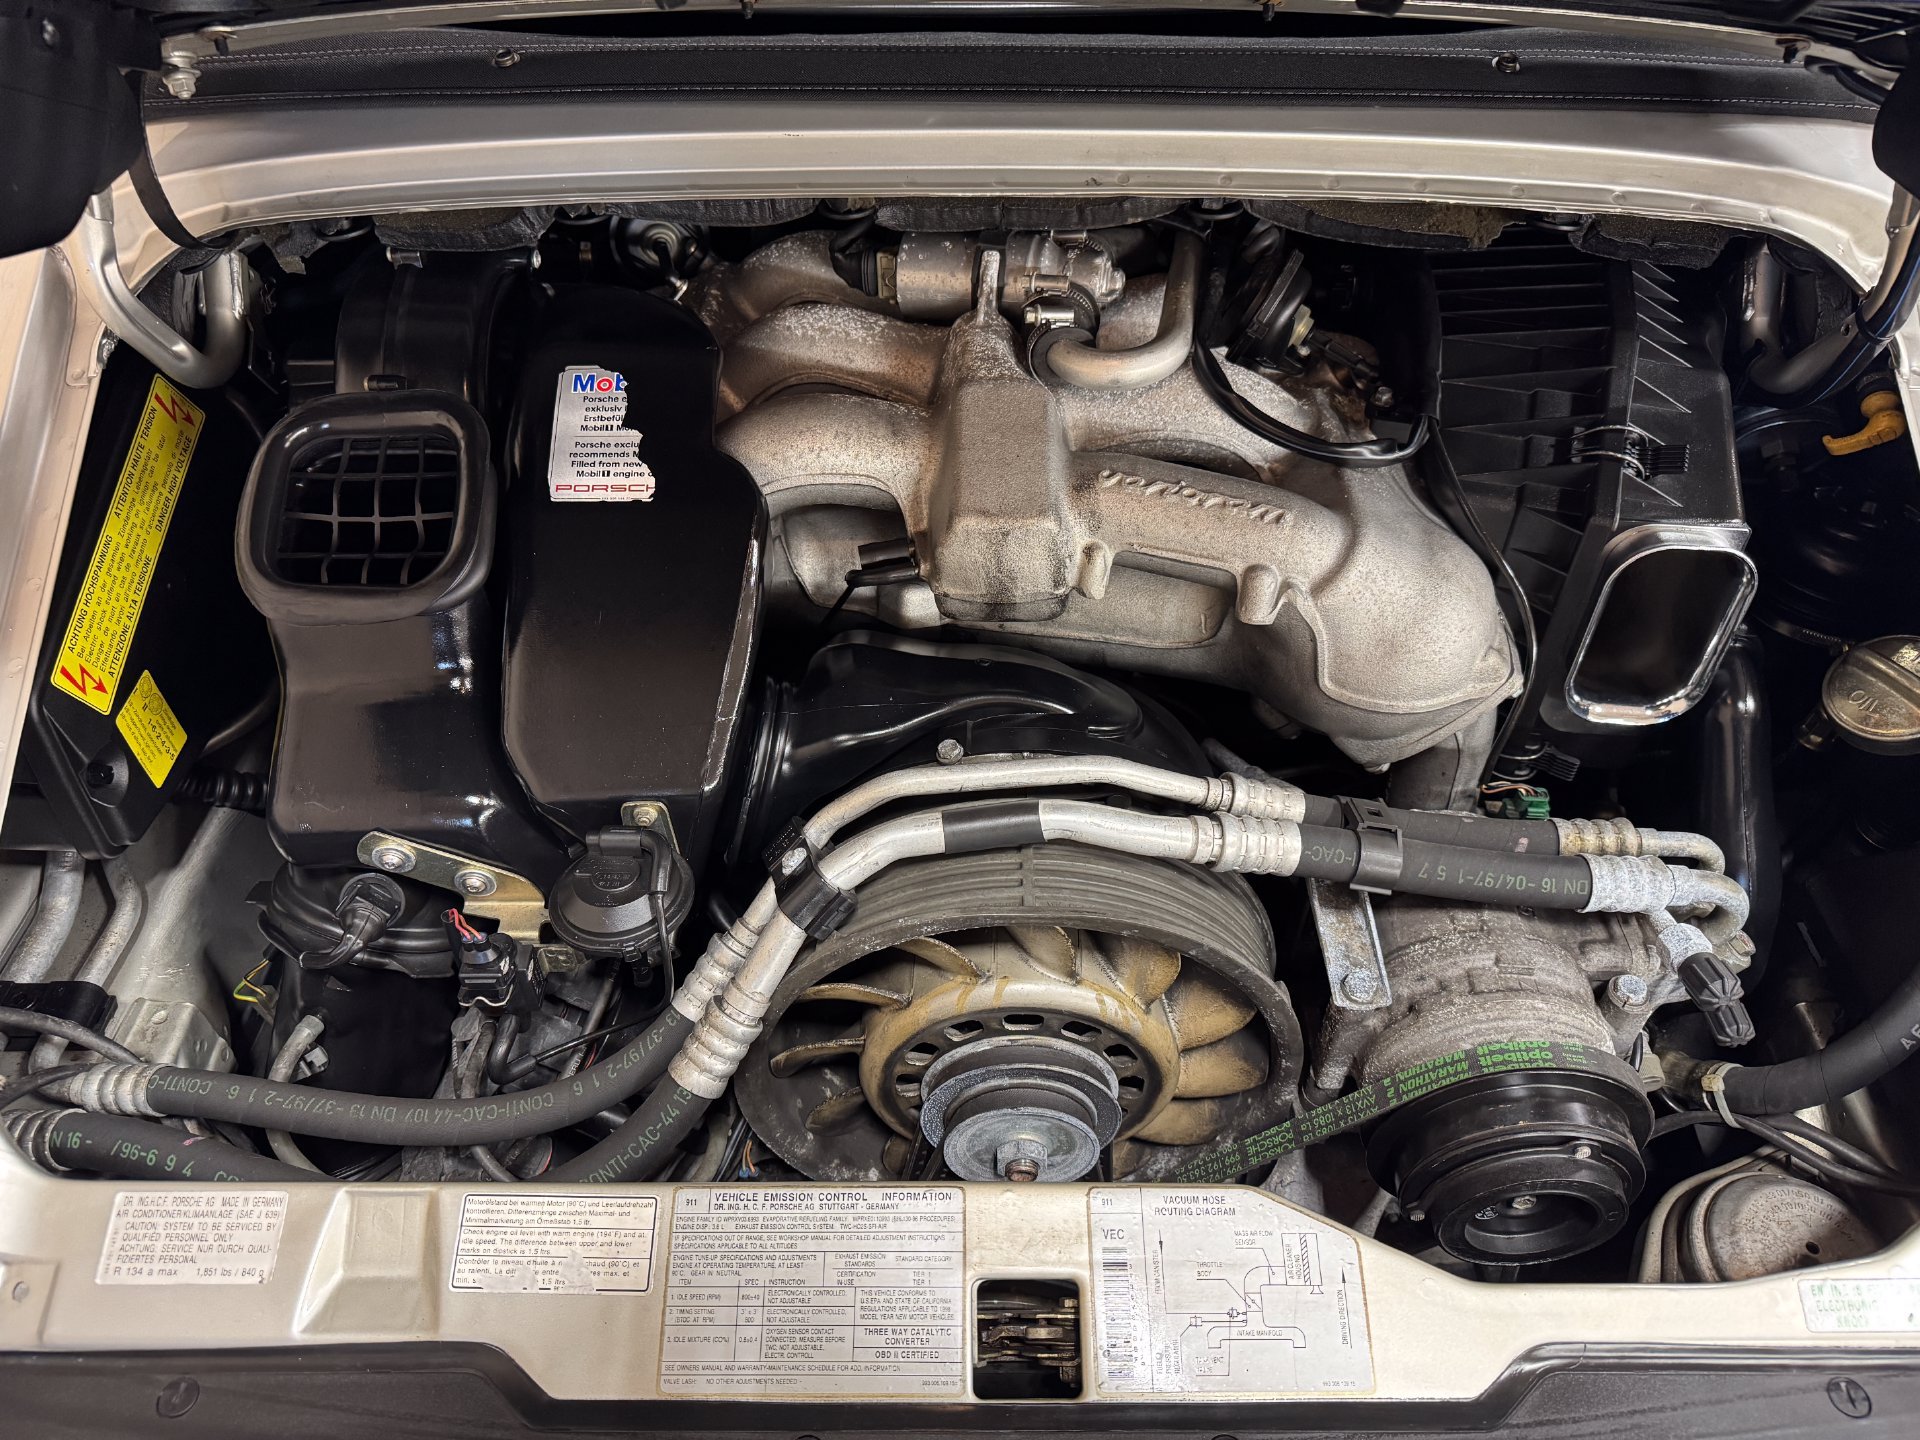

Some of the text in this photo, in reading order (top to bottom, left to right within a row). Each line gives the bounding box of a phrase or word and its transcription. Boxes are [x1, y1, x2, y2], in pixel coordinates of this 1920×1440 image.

[68, 406, 157, 653] ACHTUNG HOCHSPANNUNG ATTENTION HAUTE TENSION
[109, 436, 192, 678] ATTENZIONE ALTA TENSIONE DANGER HIGH VOLTAGE
[85, 523, 137, 663] Electric shock suffered working
[1541, 876, 1557, 893] 16
[1564, 878, 1588, 894] DN
[1479, 1051, 1553, 1067] optibelt
[1400, 1061, 1468, 1093] MARATHON
[67, 1132, 82, 1148] 16
[1248, 1129, 1294, 1156] PORSCHE
[715, 1193, 952, 1201] VEHICLE EMISSION CONTROL INFORMATION
[1163, 1196, 1226, 1204] VACUUM HOSE
[172, 1197, 202, 1207] PORSCHE
[206, 1197, 214, 1207] AG
[222, 1197, 240, 1207] MADE
[243, 1197, 249, 1207] IN
[252, 1197, 283, 1207] GERMANY
[1155, 1208, 1236, 1216] ROUTING DIAGRAM
[163, 1222, 193, 1231] SYSTEM
[199, 1223, 207, 1231] TO
[212, 1223, 221, 1231] BE
[226, 1223, 262, 1231] SERVICED
[267, 1223, 277, 1231] BY
[123, 1233, 233, 1242] QUALIFIED PERSONNEL ONLY
[573, 1231, 594, 1239] engine
[1103, 1229, 1125, 1240] VEC
[162, 1244, 194, 1253] SERVICE
[199, 1245, 213, 1253] NUR
[218, 1245, 243, 1253] DURCH
[117, 1255, 197, 1263] FIZIERTES PERSONAL
[114, 1267, 121, 1275] R
[221, 1268, 231, 1276] lbs
[242, 1268, 256, 1276] 840
[865, 1328, 952, 1336] THREE WAY CATALYTIC
[901, 1351, 939, 1359] CERTIFIED
